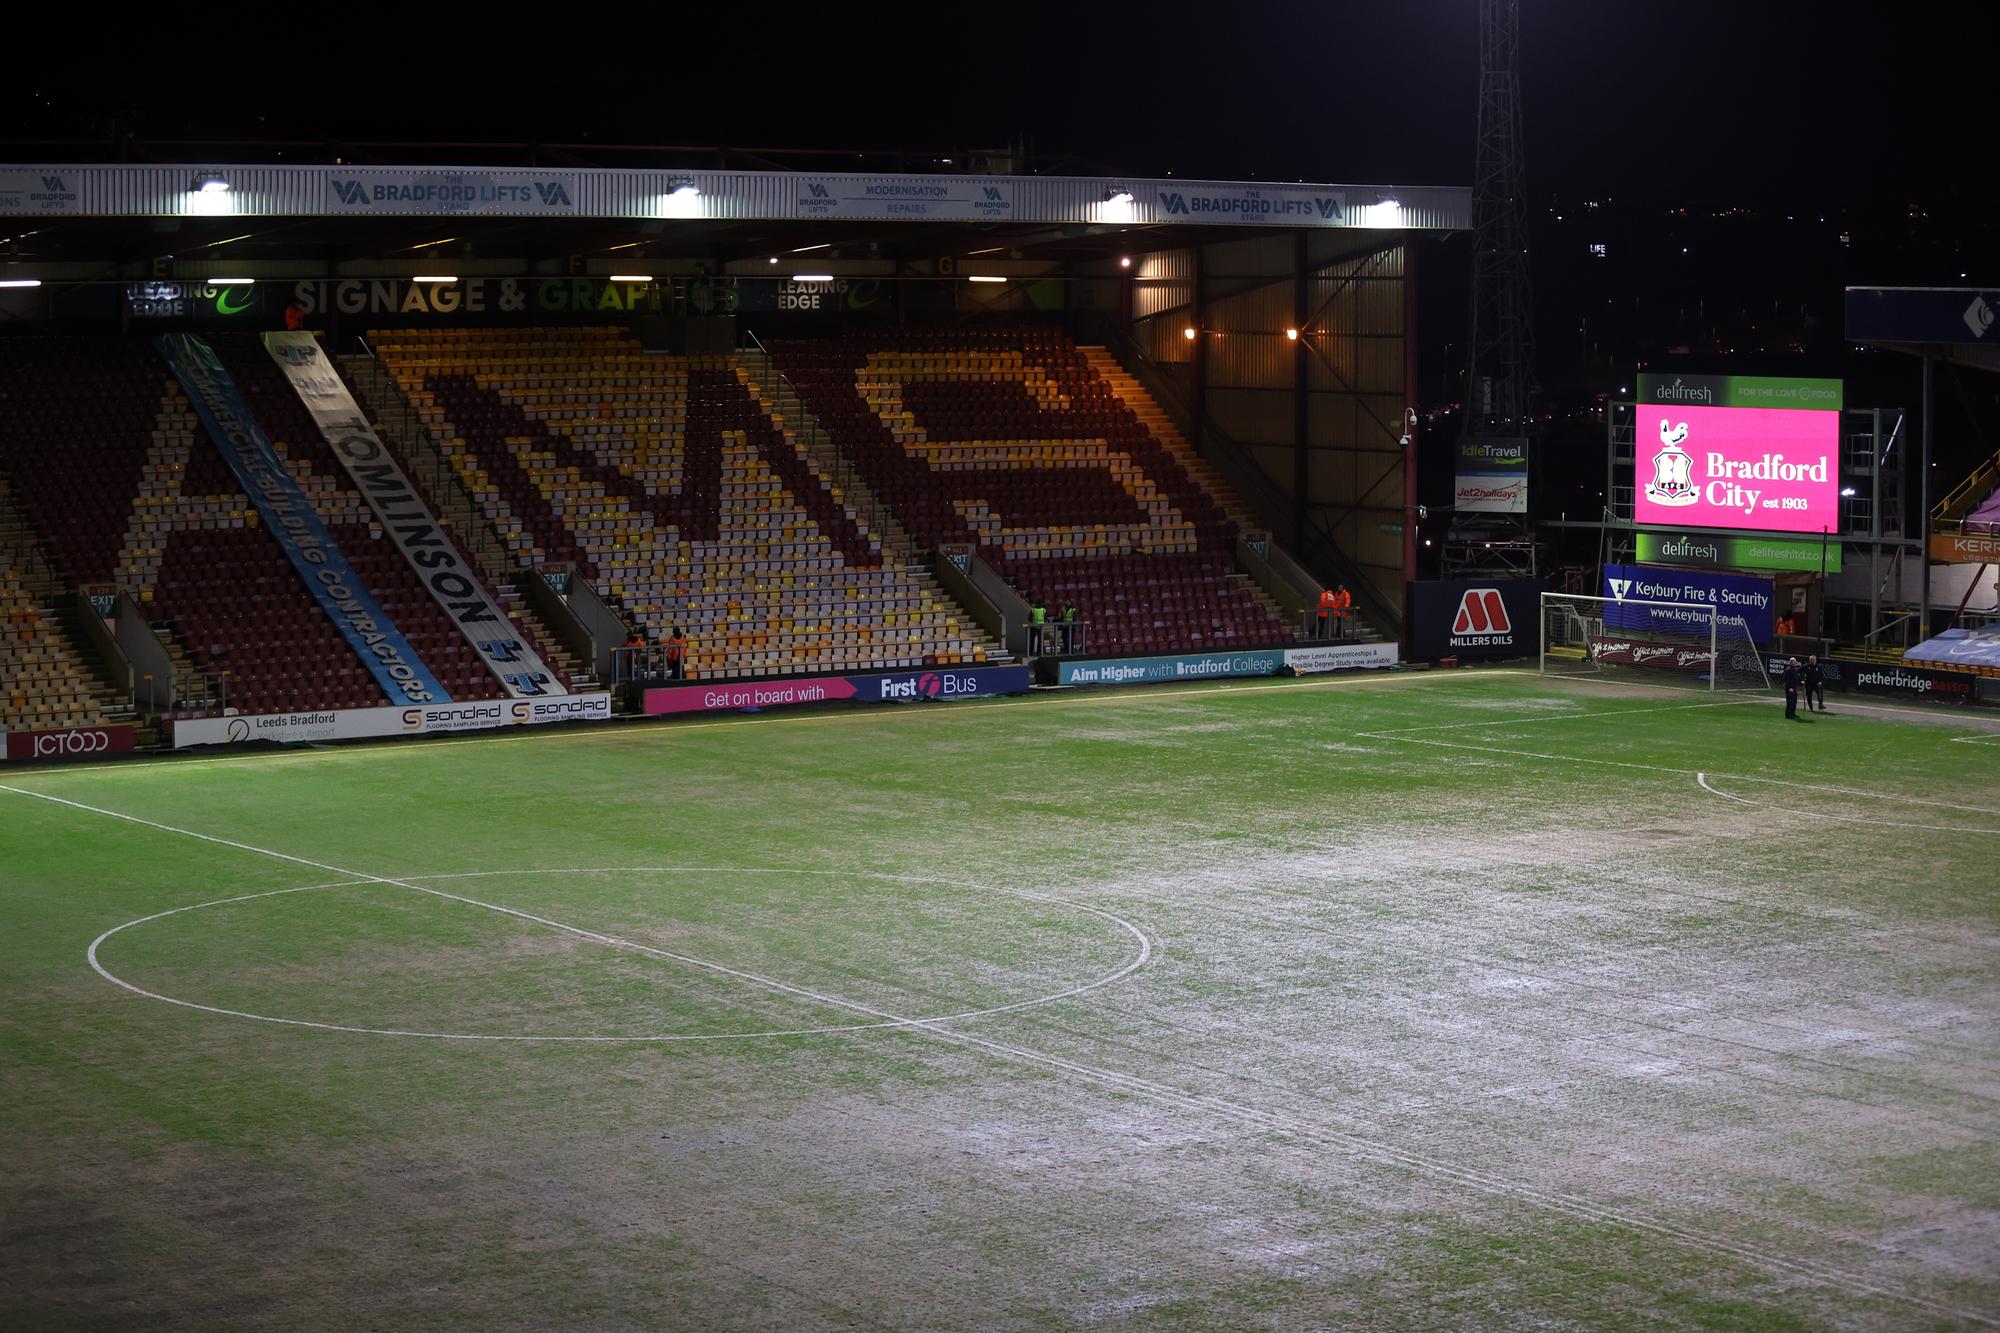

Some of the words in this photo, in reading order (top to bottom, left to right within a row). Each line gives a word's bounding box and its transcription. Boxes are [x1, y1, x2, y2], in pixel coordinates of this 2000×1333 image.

[30, 193, 76, 201] BRADFORD
[373, 185, 476, 201] BRADFORD
[480, 185, 532, 201] LIFTS
[865, 185, 948, 197] MODERNISATION
[41, 200, 65, 209] LIFTS
[799, 198, 838, 207] BRADFORD
[887, 203, 927, 214] REPAIRS
[1191, 197, 1270, 214] BRADFORD
[1273, 201, 1313, 215] LIFTS
[982, 208, 1001, 216] LIFTS
[937, 256, 953, 273] G
[132, 283, 218, 300] LEADING
[777, 280, 849, 295] LEADING
[293, 280, 486, 314] SIGNAGE
[498, 280, 527, 312] &
[777, 295, 822, 310] EDGE
[1656, 384, 1712, 404] delifresh
[1738, 387, 1756, 396] FOR
[1757, 388, 1774, 397] THE
[1775, 389, 1798, 398] LOVE
[1811, 390, 1837, 399] FOOD
[1462, 445, 1521, 457] IdleTravel
[1707, 452, 1828, 483] Bradford
[1457, 488, 1517, 500] Jet2holidays
[1706, 481, 1761, 515] City
[1763, 498, 1779, 509] est
[1782, 498, 1808, 510] 1903
[331, 416, 499, 624] TOMLINSON
[1662, 541, 1718, 563] delifresh
[1962, 554, 2000, 564] LOGISTI
[544, 573, 567, 584] EXIT
[256, 474, 328, 564] BUILDING
[317, 569, 433, 702] CONTRACTORS
[1636, 581, 1681, 598] Keybury
[1684, 586, 1705, 600] Fire
[1708, 588, 1718, 602] &
[1721, 589, 1769, 610] Security
[90, 595, 115, 606] EXIT
[1650, 607, 1745, 627] www.keyburyco.uk
[1449, 636, 1490, 647] MILLERS
[1491, 635, 1513, 646] OILS
[1291, 653, 1311, 661] Higher
[1311, 652, 1327, 660] Level
[1328, 650, 1372, 660] Apprenticeships
[1314, 660, 1334, 668] Degree
[1335, 659, 1350, 668] Study
[1366, 658, 1391, 666] available
[1071, 668, 1098, 681] Aim
[1101, 666, 1145, 682] Higher
[1149, 664, 1173, 677] with
[1176, 658, 1230, 675] Bradford
[1233, 657, 1274, 673] College
[1820, 663, 1841, 680] NG.
[881, 678, 917, 697] First
[943, 674, 977, 694] Bus
[704, 691, 731, 707] Get
[733, 692, 750, 705] on
[755, 687, 793, 704] board
[798, 686, 825, 702] with
[426, 704, 500, 722] sondad
[534, 697, 607, 715] sondad
[256, 715, 287, 728] Leeds
[290, 713, 336, 726] Bradford
[306, 728, 335, 741] Airport
[32, 729, 109, 758] JCT600
